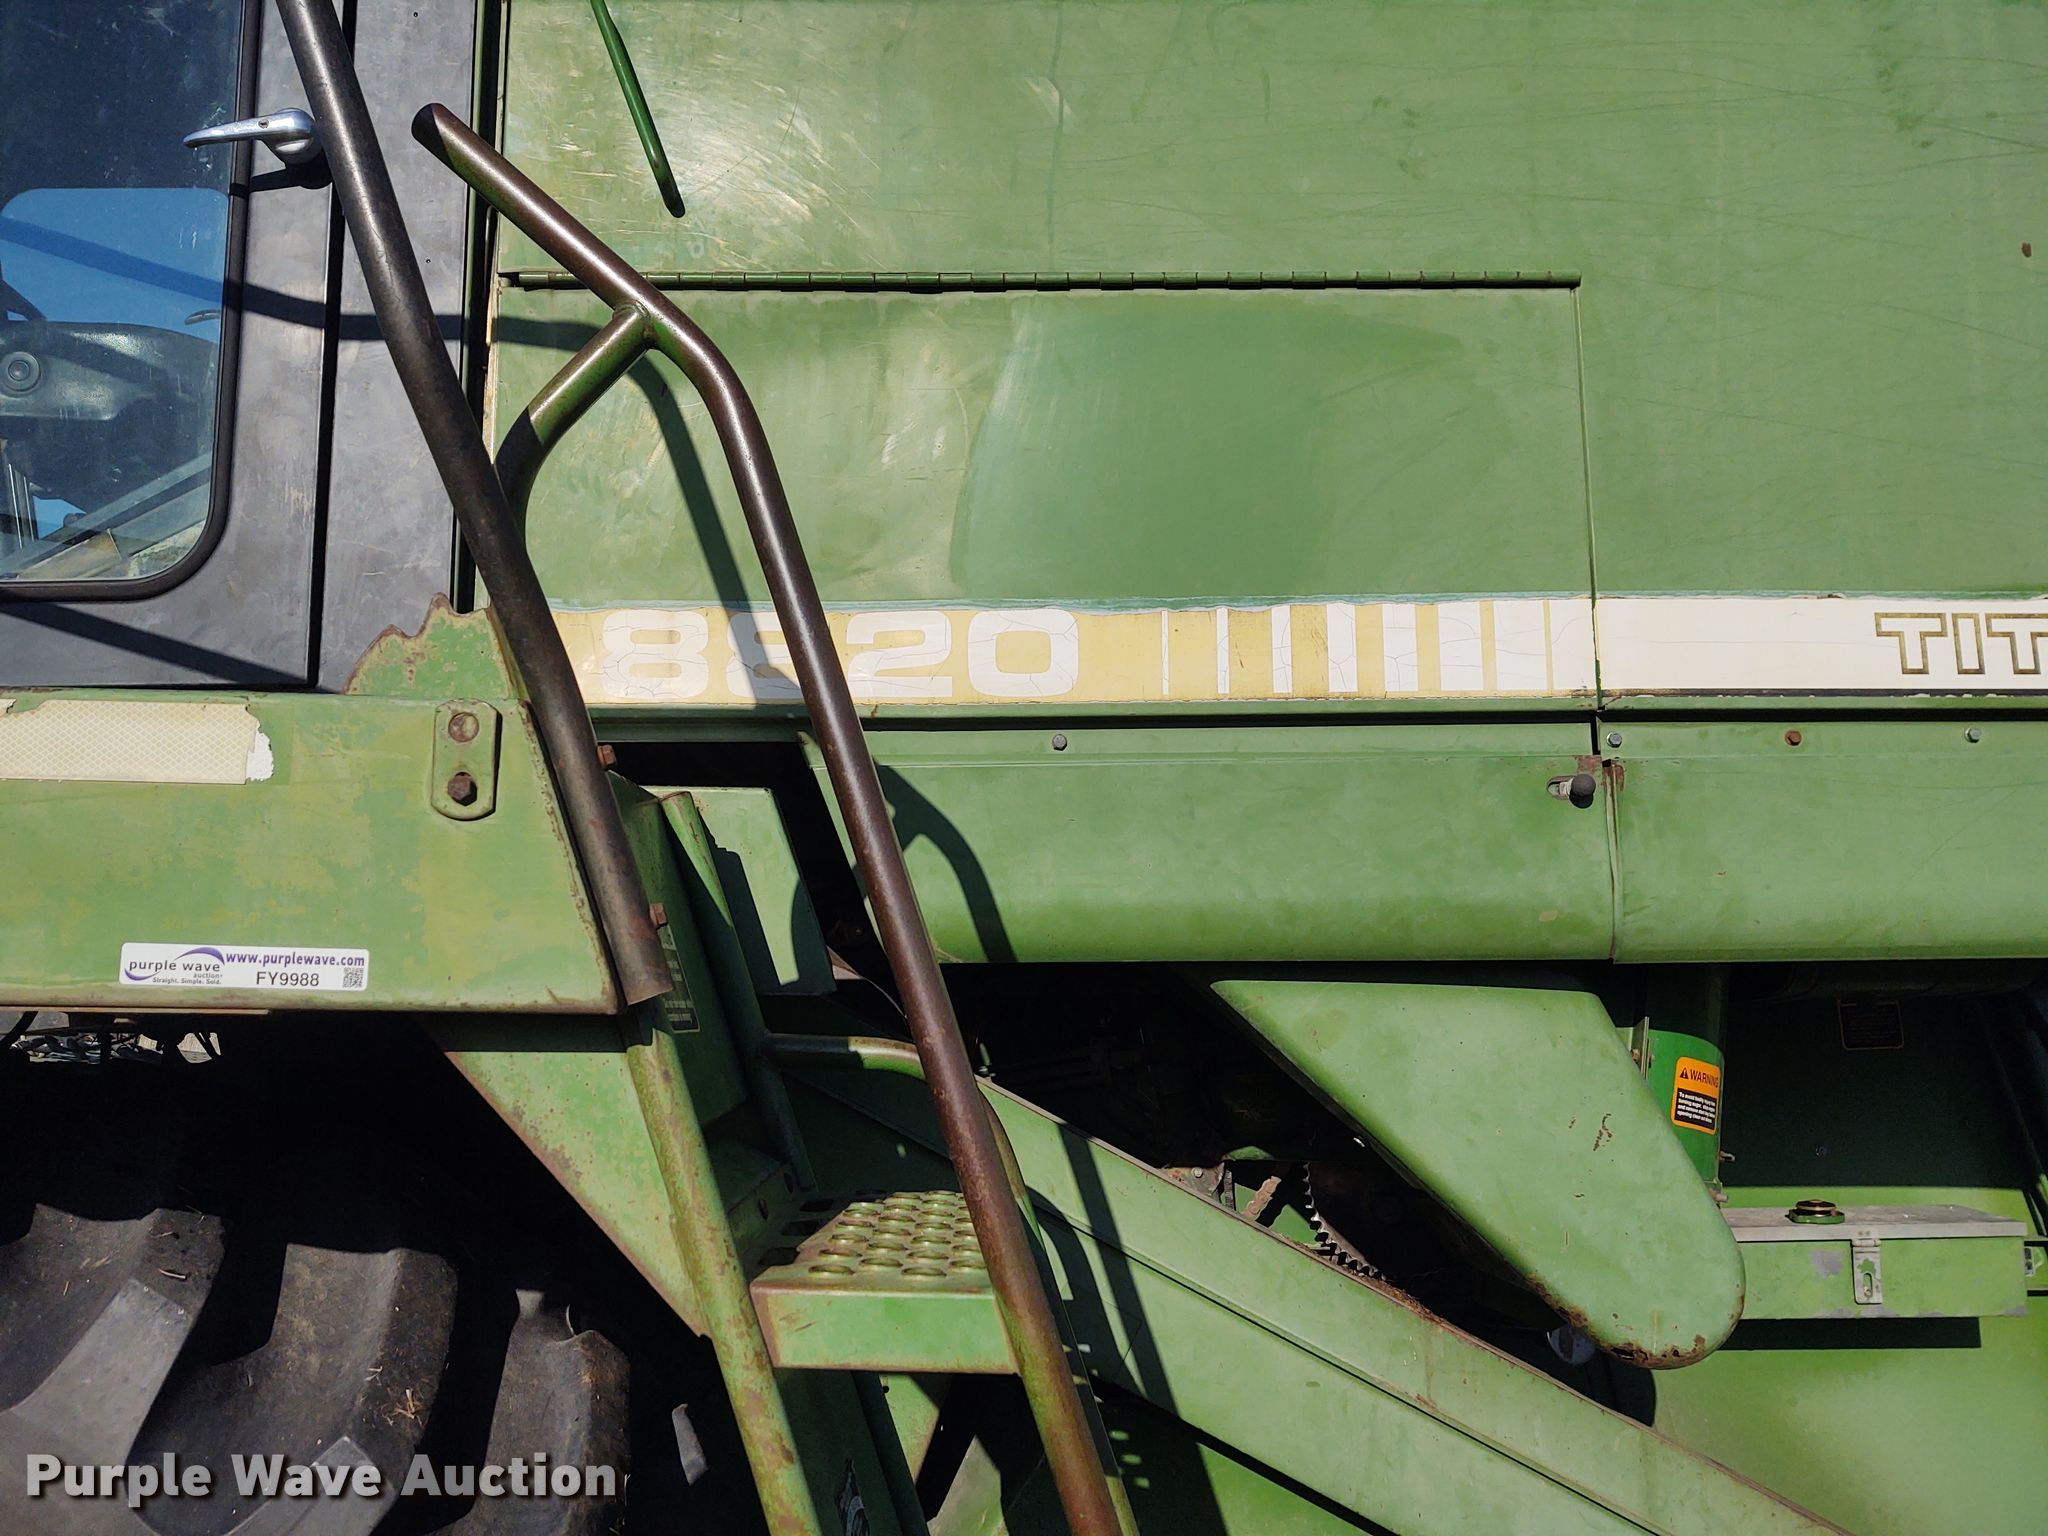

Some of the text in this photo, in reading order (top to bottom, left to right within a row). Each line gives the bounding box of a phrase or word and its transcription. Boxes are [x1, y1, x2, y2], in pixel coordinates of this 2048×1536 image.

[602, 607, 1079, 699] 8820
[129, 960, 220, 972] purple wave
[226, 951, 365, 968] www.purplewave.com
[256, 971, 320, 987] FY9988
[1690, 1069, 1719, 1088] WARNING
